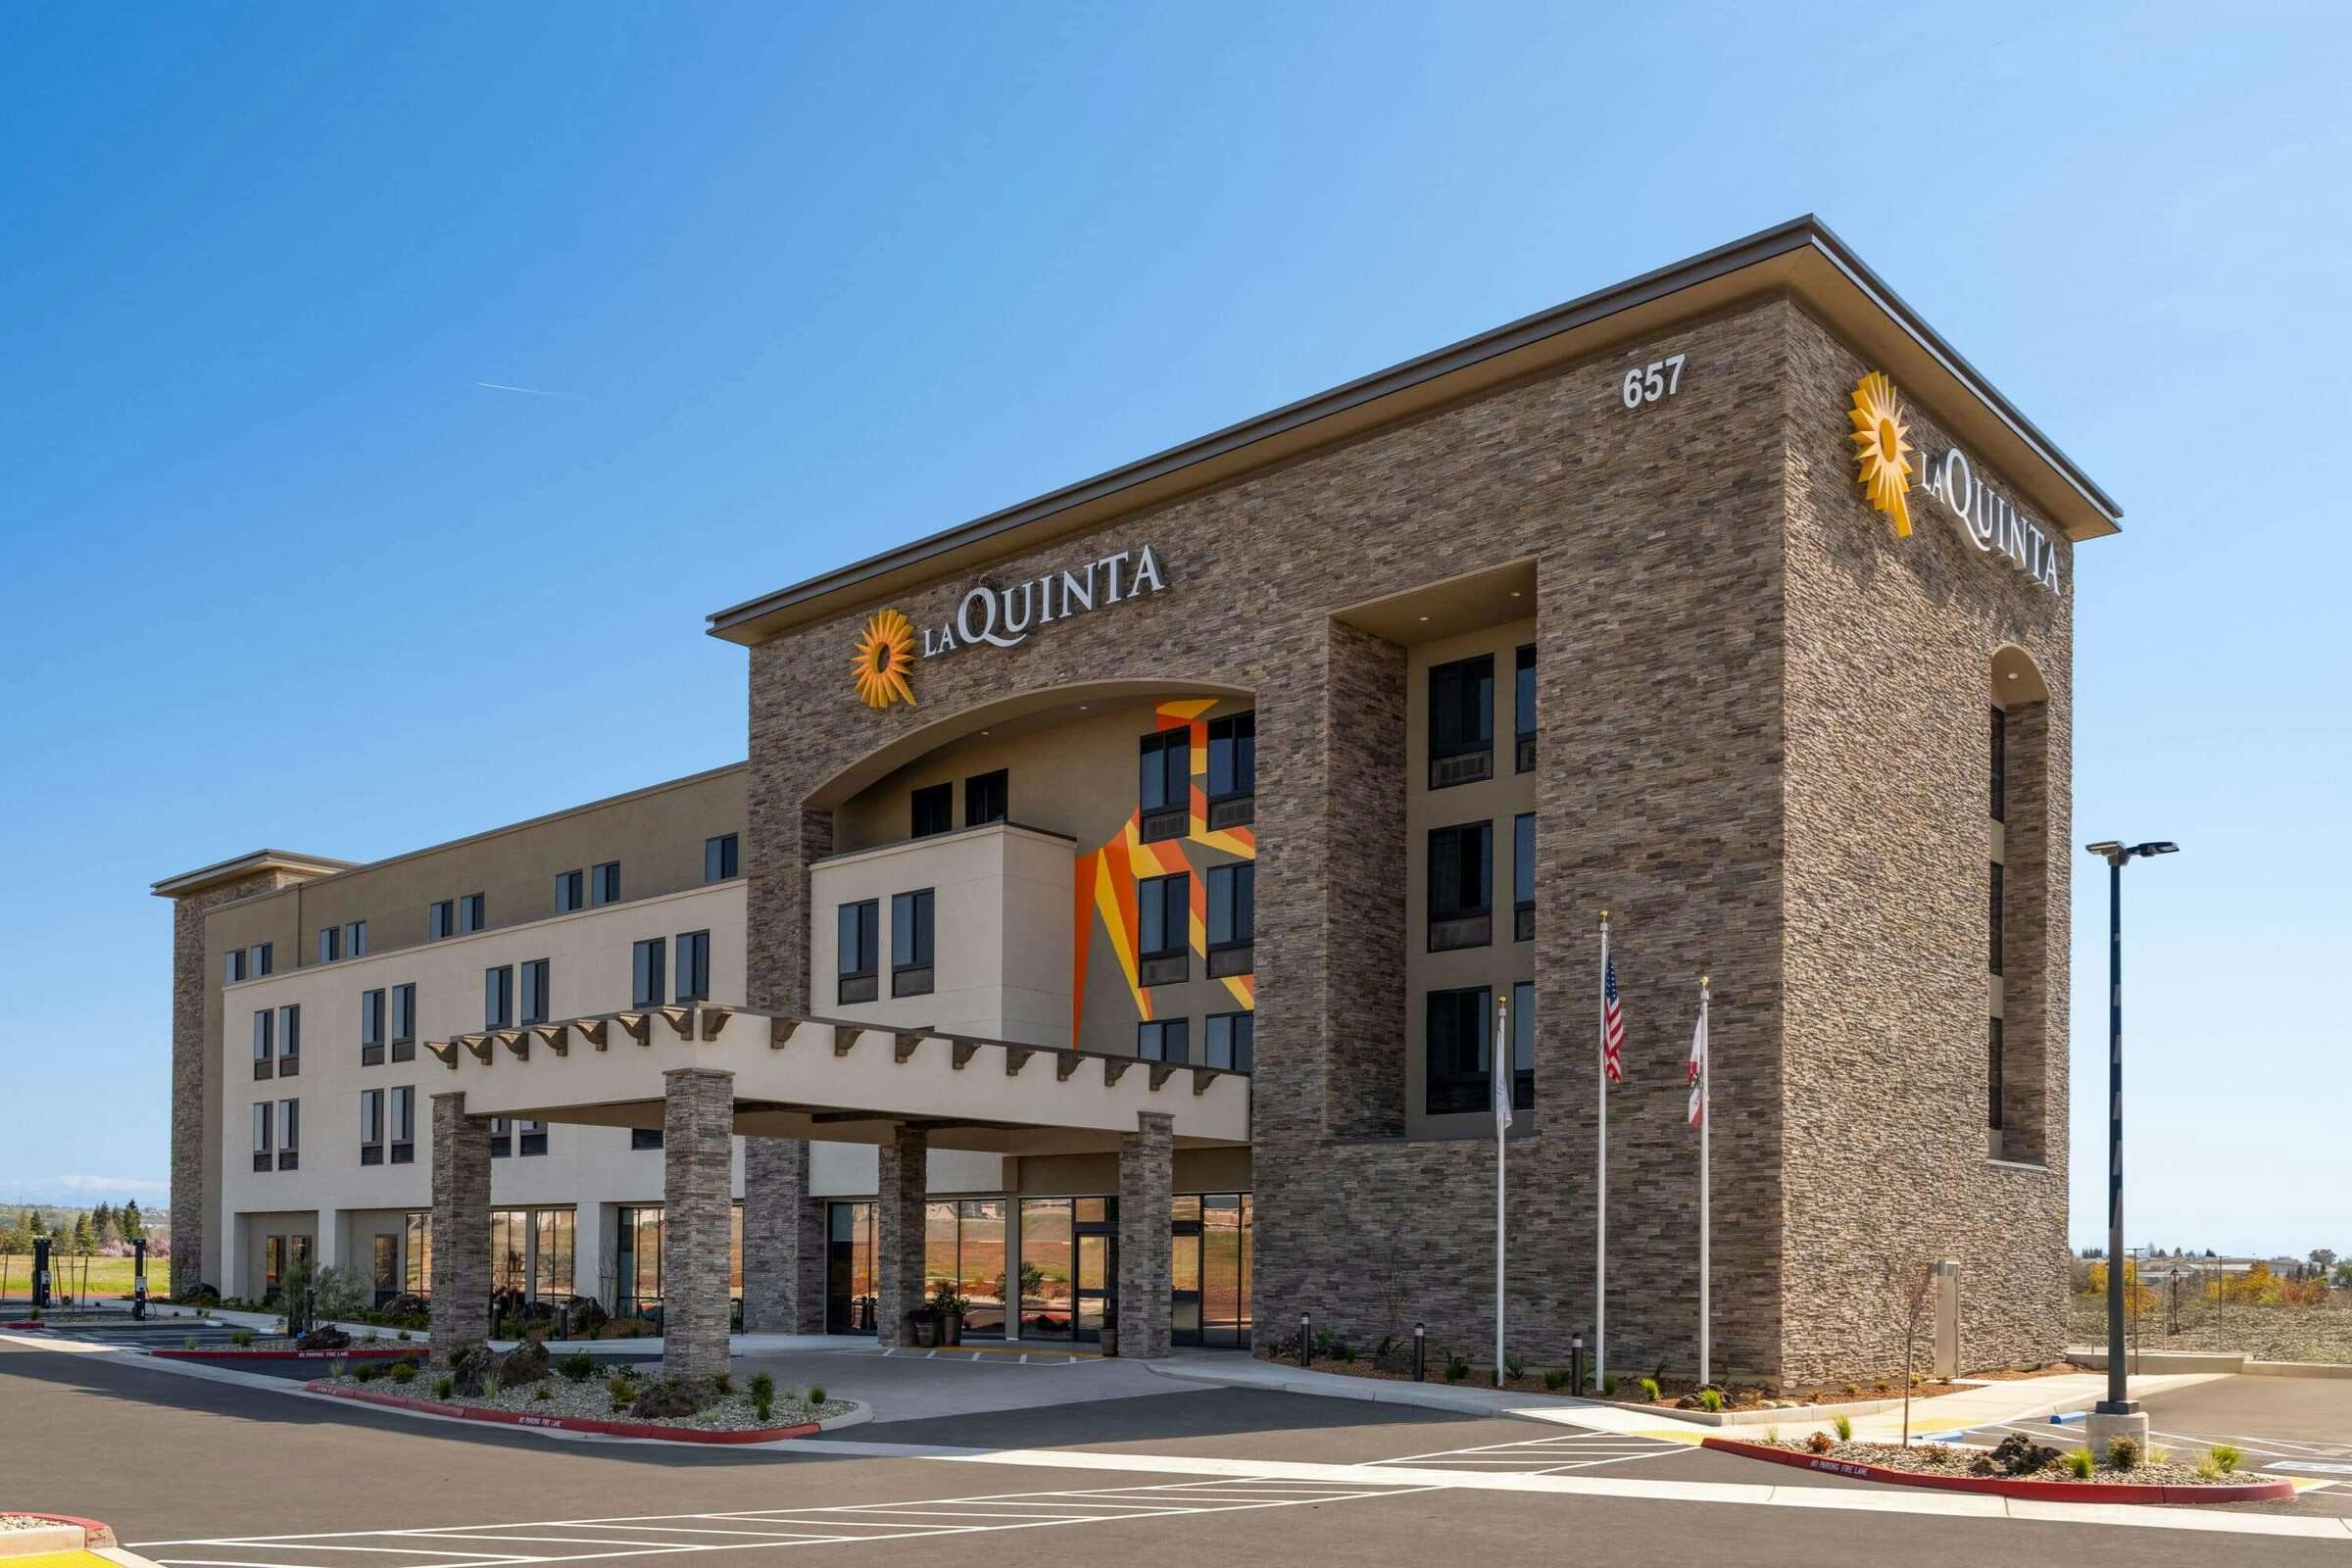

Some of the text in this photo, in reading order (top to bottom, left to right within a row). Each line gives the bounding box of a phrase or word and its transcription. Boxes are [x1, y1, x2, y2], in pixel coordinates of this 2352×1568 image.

[1623, 353, 1686, 408] 657
[1920, 447, 2061, 597] LA QUINTA
[923, 544, 1165, 659] LA QUINTA
